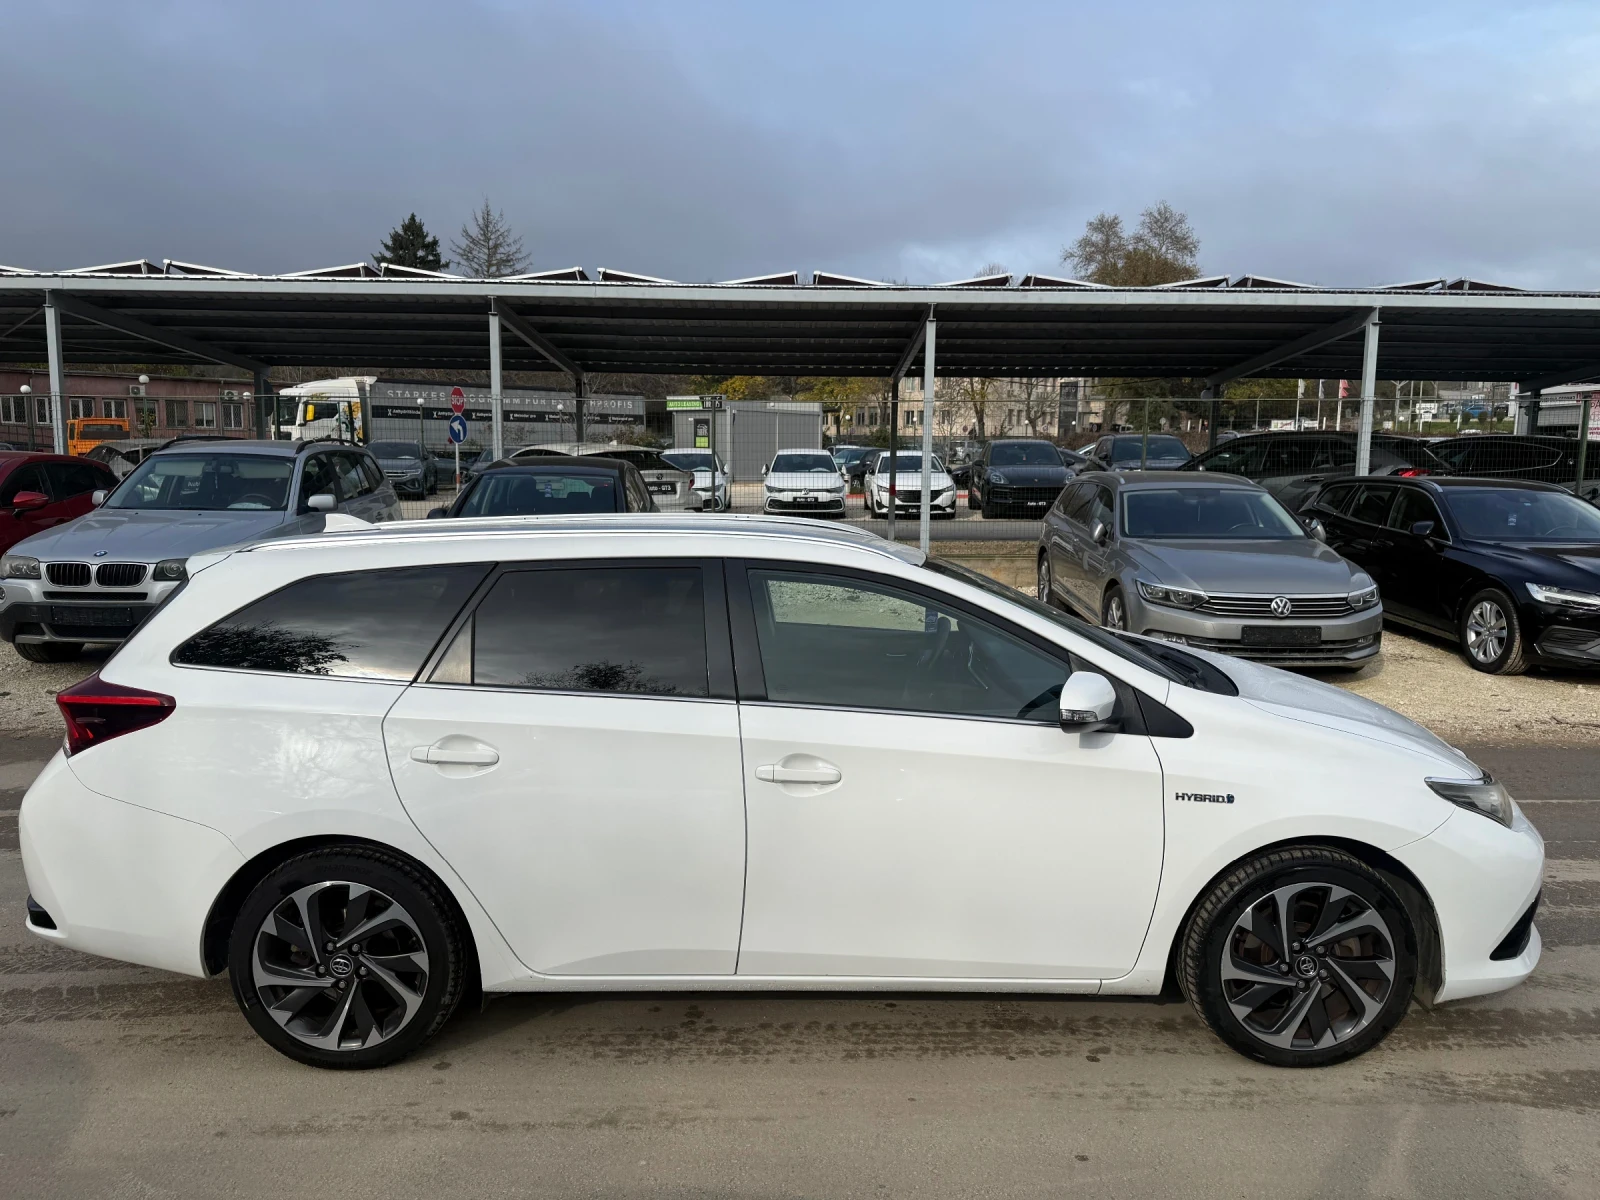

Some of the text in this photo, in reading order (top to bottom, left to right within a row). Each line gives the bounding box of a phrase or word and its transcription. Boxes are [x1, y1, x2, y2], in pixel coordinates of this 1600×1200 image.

[387, 389, 446, 401] STARKES
[451, 394, 464, 405] STOP
[1175, 792, 1226, 803] HYBRID
